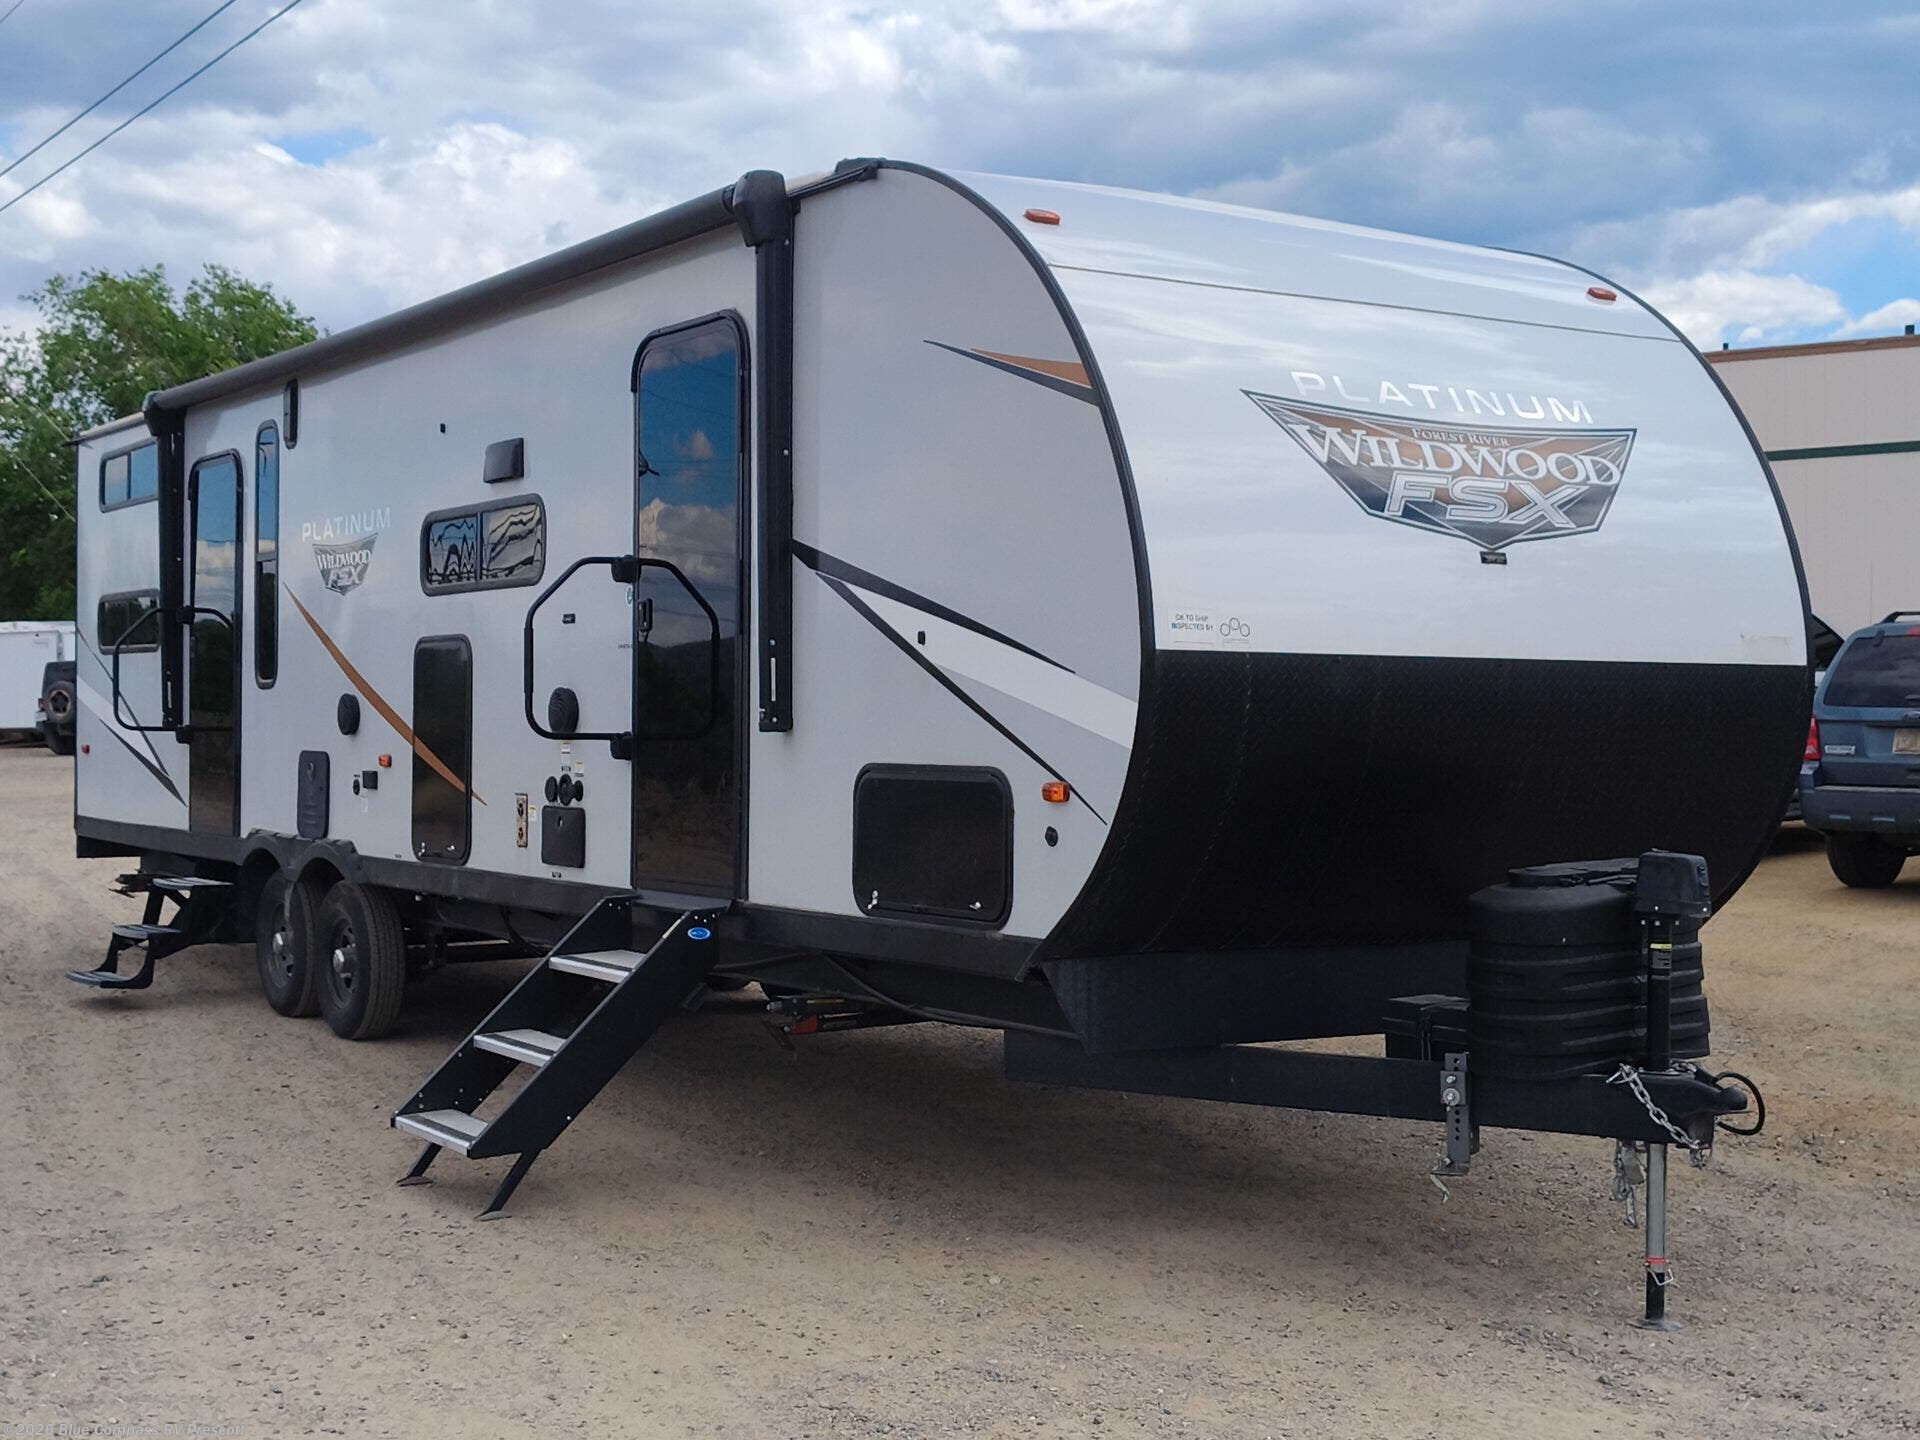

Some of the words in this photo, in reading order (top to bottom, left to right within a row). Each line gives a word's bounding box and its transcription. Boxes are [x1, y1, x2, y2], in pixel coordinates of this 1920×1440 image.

[1291, 371, 1594, 425] PLATINUM
[1287, 423, 1622, 487] WILDWOOD
[1384, 472, 1590, 530] FSX
[301, 507, 392, 543] PLATINUM
[316, 549, 372, 570] WILDWOOD
[1186, 614, 1195, 622] TO
